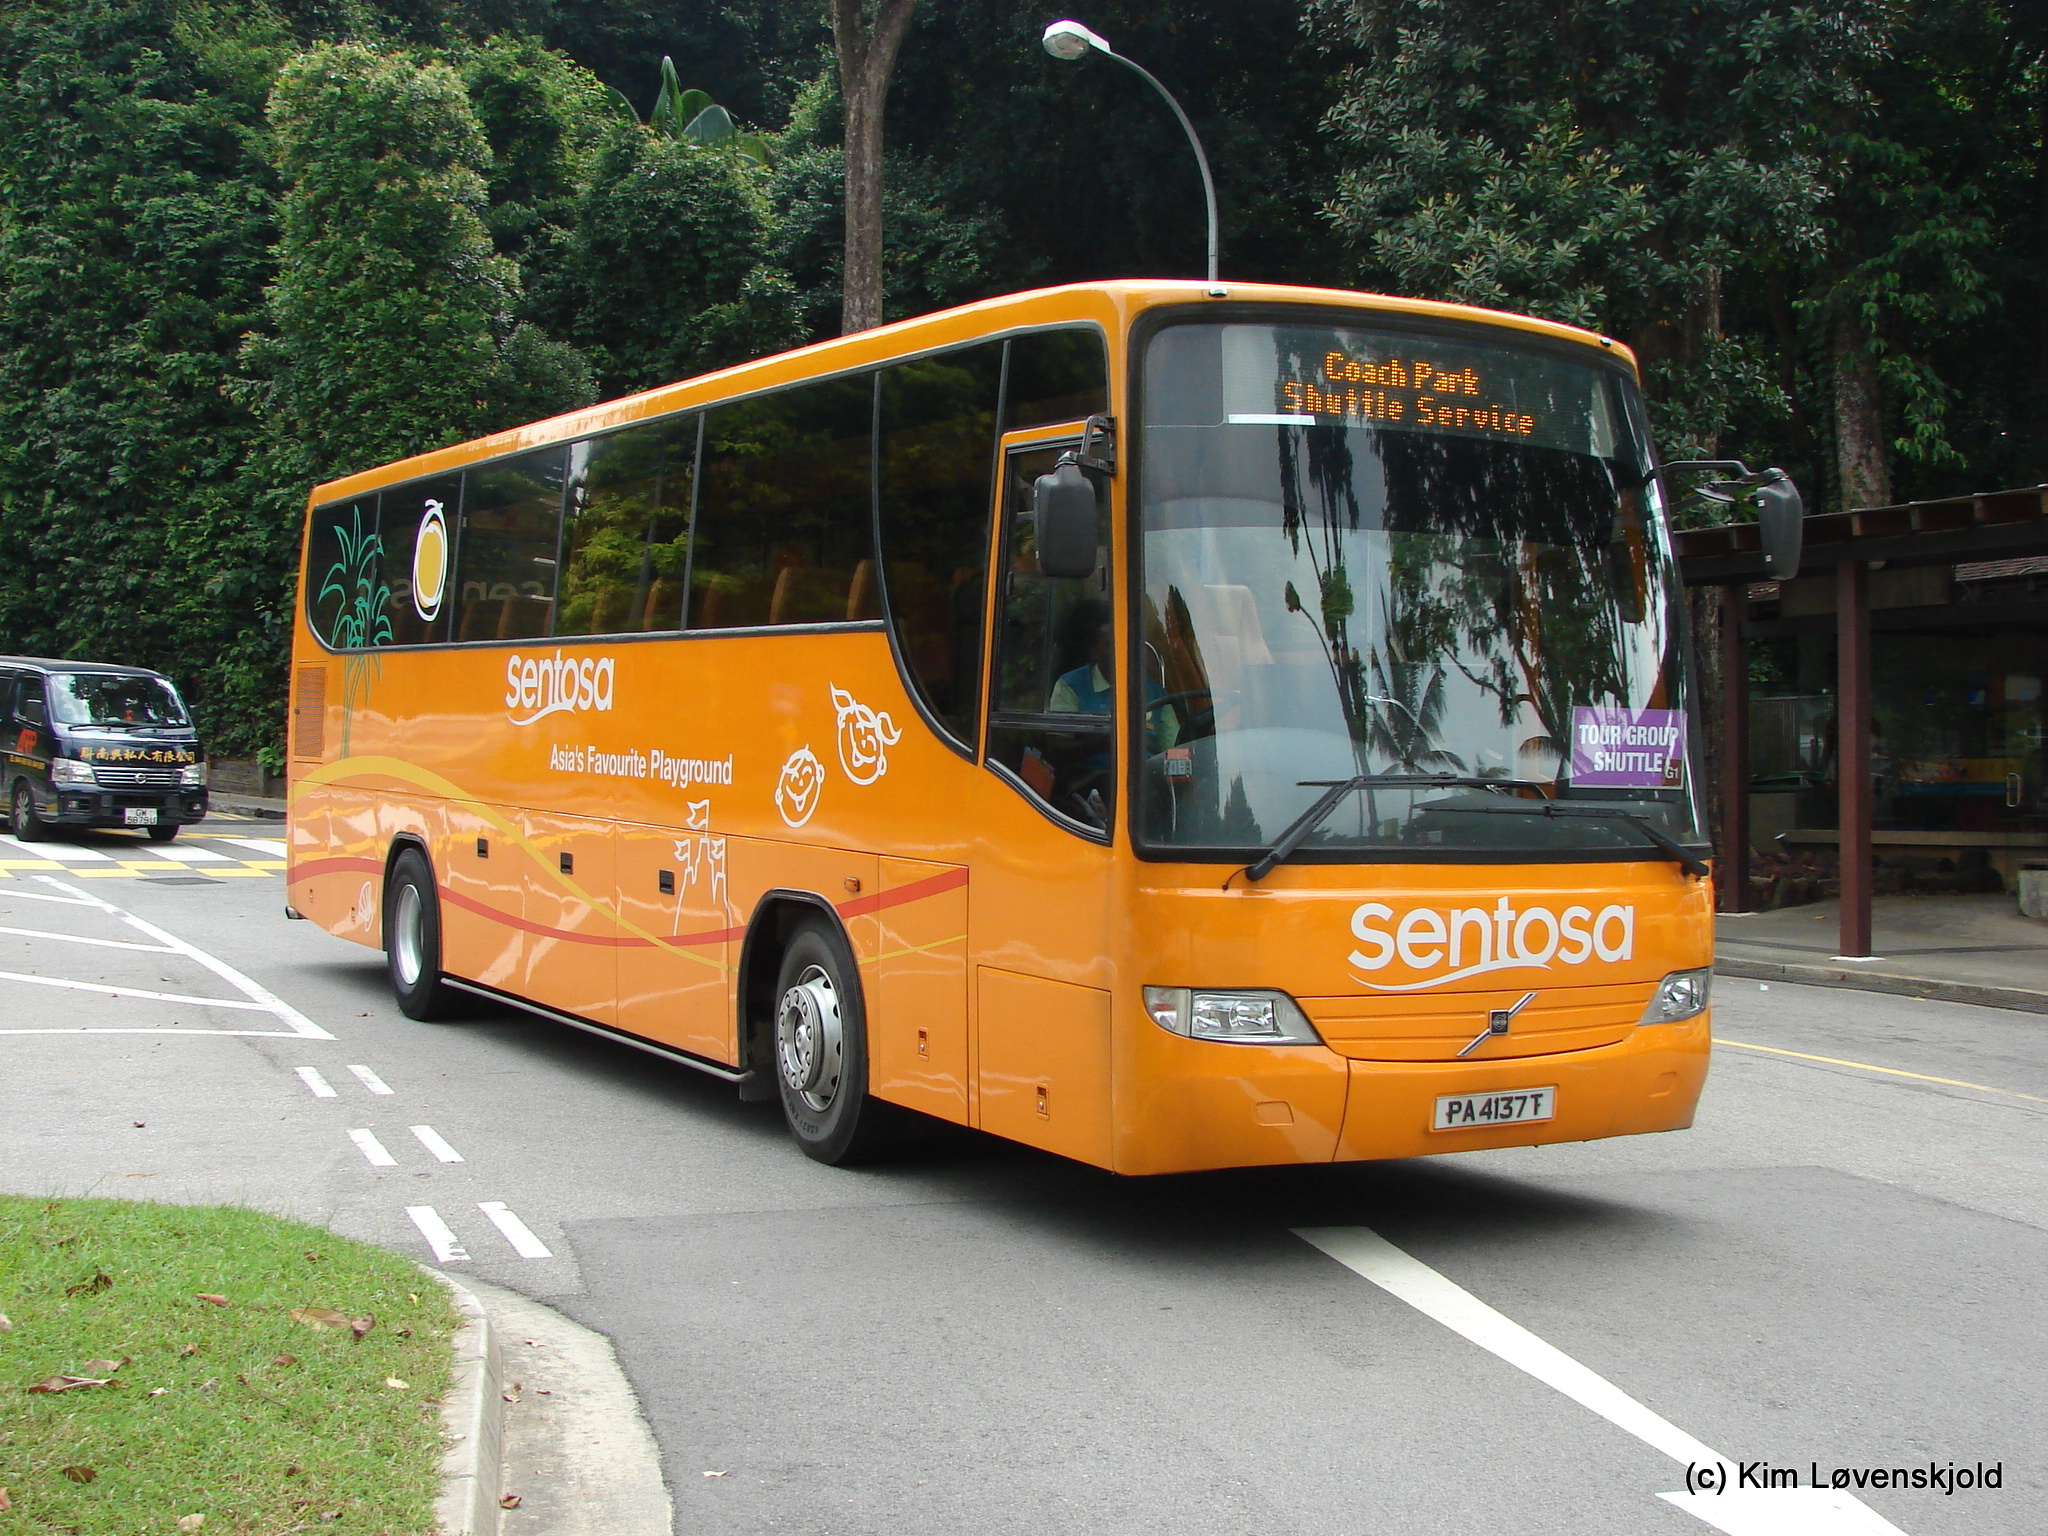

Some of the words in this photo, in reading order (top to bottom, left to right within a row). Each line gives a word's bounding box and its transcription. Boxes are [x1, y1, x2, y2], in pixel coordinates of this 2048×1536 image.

[1325, 352, 1407, 388] Coach
[1414, 362, 1480, 395] Park
[1284, 382, 1403, 420] Shuttle
[1416, 397, 1534, 434] Service
[505, 648, 615, 713] sentosa
[1578, 724, 1621, 745] TOUR
[1625, 725, 1679, 746] GROUP
[550, 743, 584, 773] Asia's
[587, 745, 647, 778] Favourite
[650, 749, 733, 789] Playground
[1593, 751, 1662, 773] SHUTTLE
[1664, 766, 1679, 779] G1
[1347, 896, 1634, 974] sentosa
[1446, 1093, 1544, 1124] PA4137T
